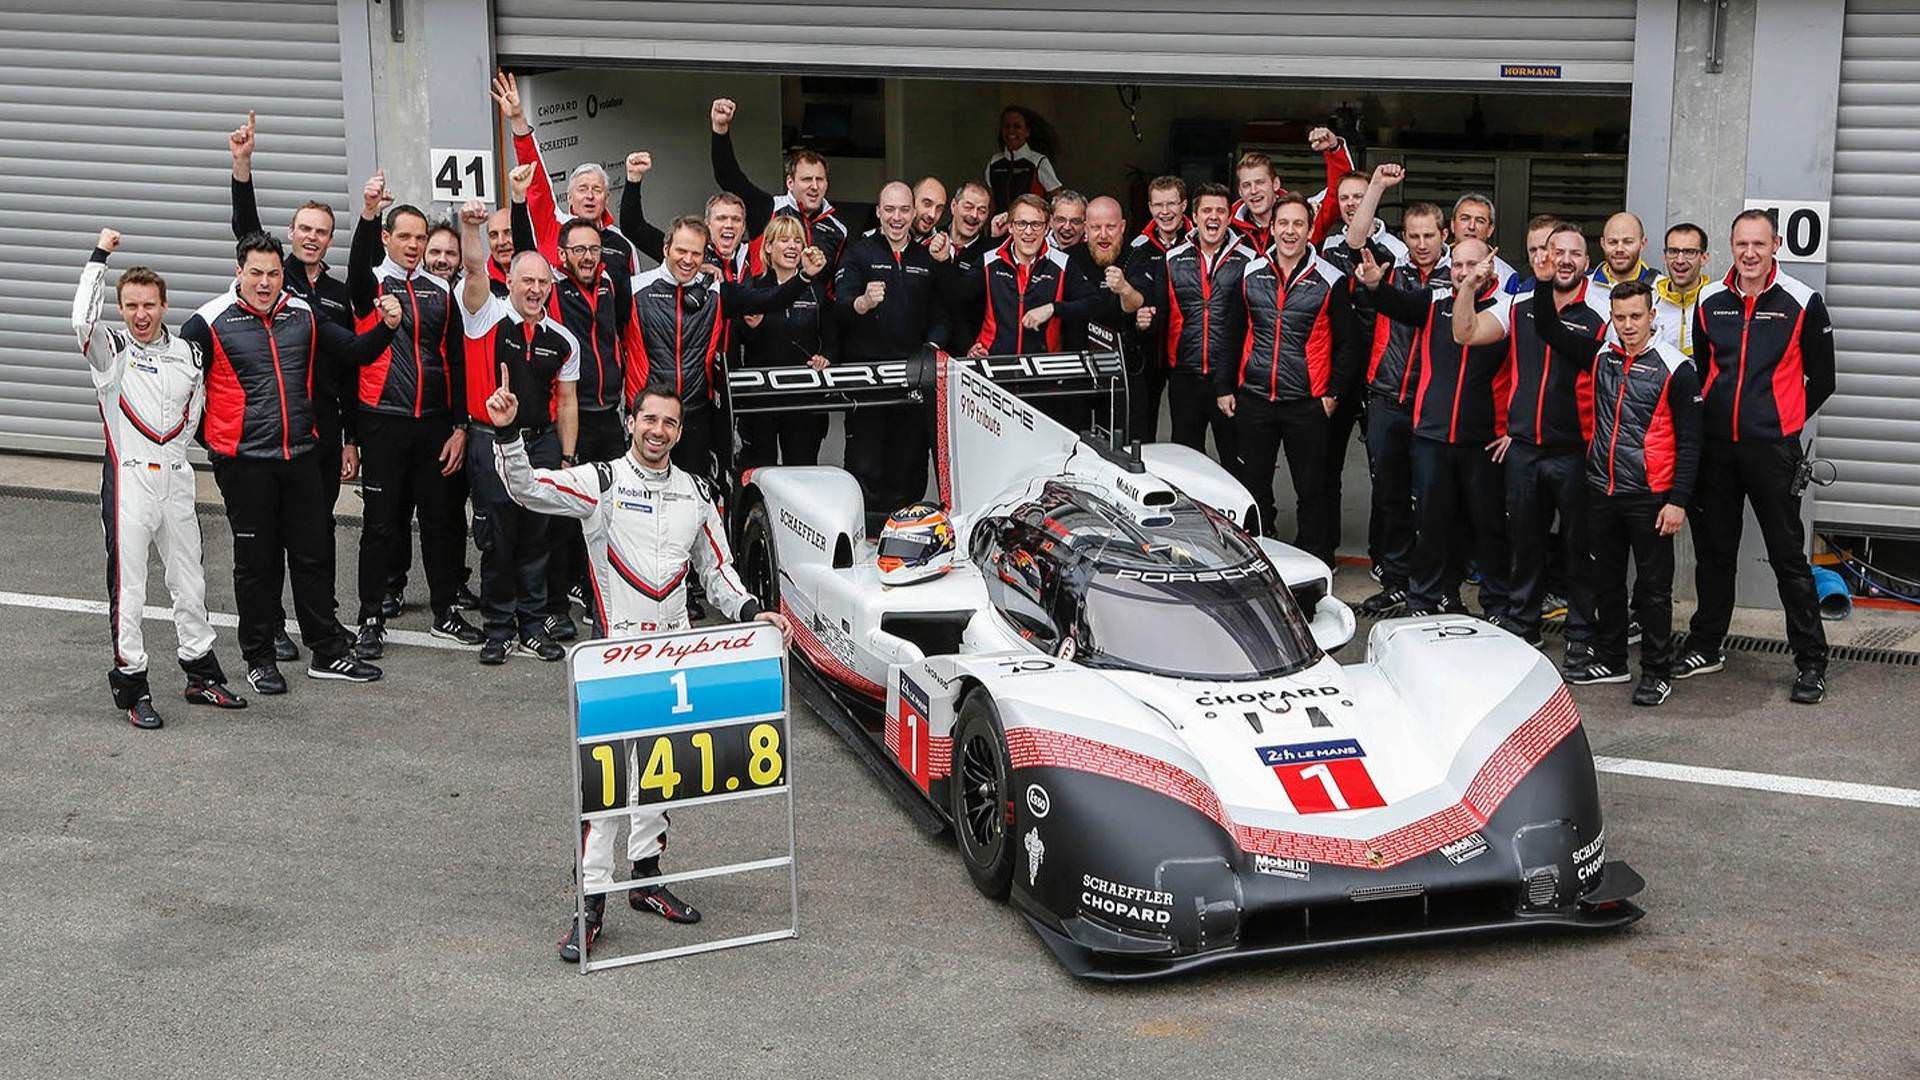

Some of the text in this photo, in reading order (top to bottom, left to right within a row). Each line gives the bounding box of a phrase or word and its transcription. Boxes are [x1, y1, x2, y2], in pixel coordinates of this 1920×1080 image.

[538, 101, 578, 116] CHOPARD
[436, 156, 485, 197] 41
[1766, 208, 1822, 257] 0
[960, 395, 1002, 437] 919 tribute
[961, 372, 1034, 431] PORSCHE
[780, 508, 826, 551] SCHAEFFLER
[1115, 559, 1269, 583] PORSCHE
[603, 631, 756, 666] 919 hybrid
[670, 671, 693, 714] 1
[1196, 686, 1340, 706] CHOPARD
[908, 714, 918, 776] 1
[1298, 751, 1315, 759] LE
[1317, 747, 1357, 758] MANS
[1300, 763, 1350, 811] 1
[1081, 892, 1171, 923] CHOPARD
[1083, 874, 1174, 906] SCHAEFFLER
